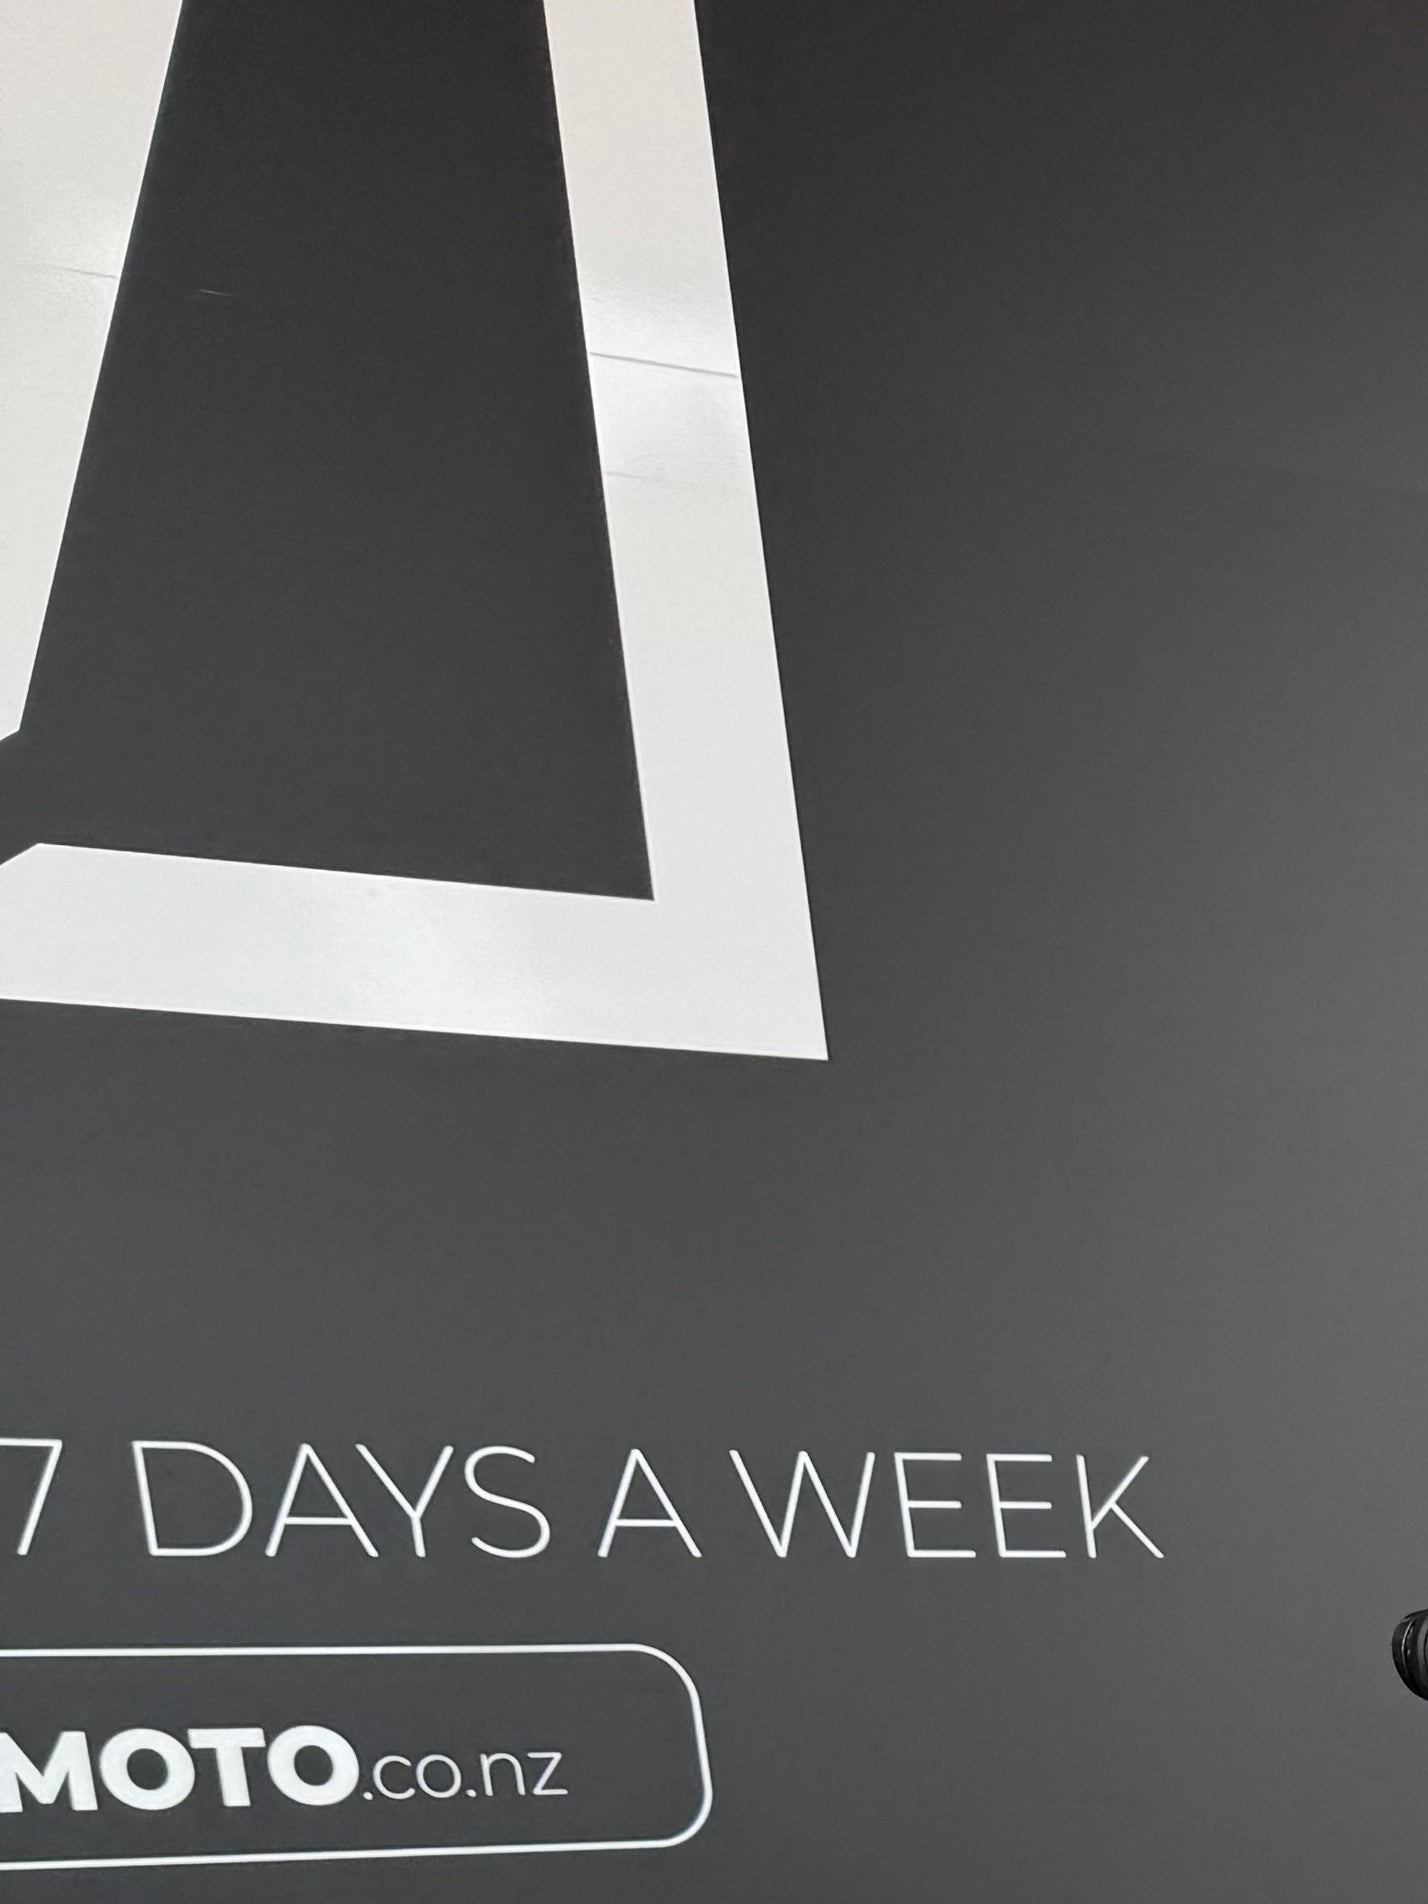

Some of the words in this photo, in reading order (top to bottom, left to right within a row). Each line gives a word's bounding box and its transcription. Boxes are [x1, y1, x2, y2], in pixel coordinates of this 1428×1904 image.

[132, 1440, 551, 1559] DAYS
[598, 1448, 702, 1558] A
[730, 1449, 1165, 1559] WEEK
